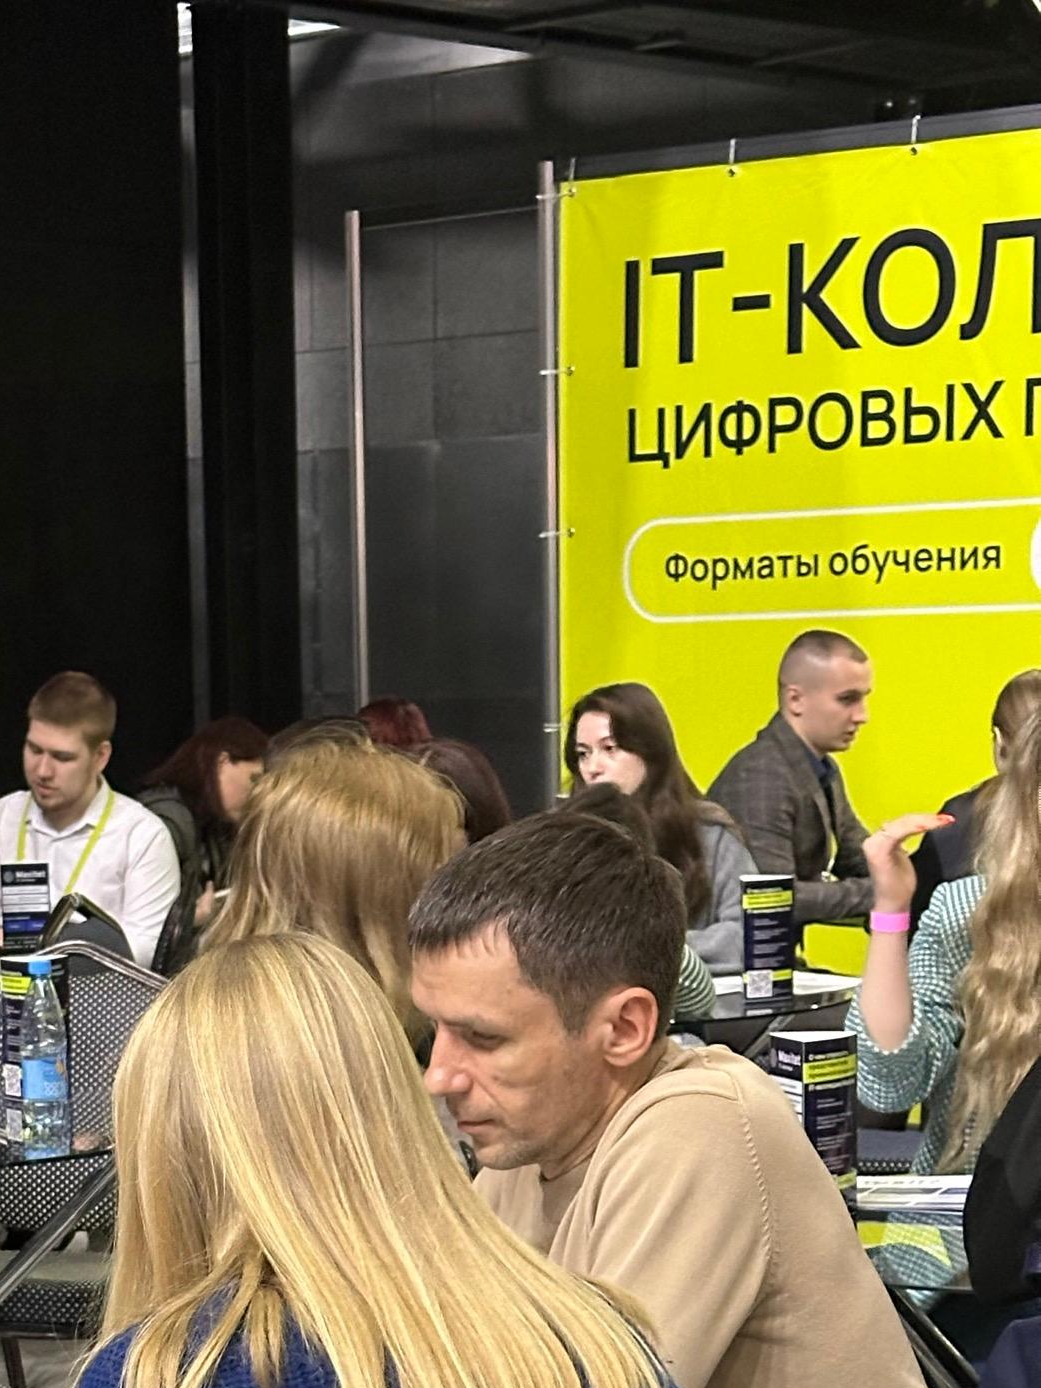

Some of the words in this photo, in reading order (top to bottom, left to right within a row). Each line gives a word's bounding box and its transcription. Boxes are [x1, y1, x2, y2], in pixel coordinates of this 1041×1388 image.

[623, 217, 1041, 369] IT-КОЛ
[627, 380, 1005, 469] ЦИФРОВЫХ
[665, 549, 819, 590] Форматы
[829, 544, 1001, 584] обучения
